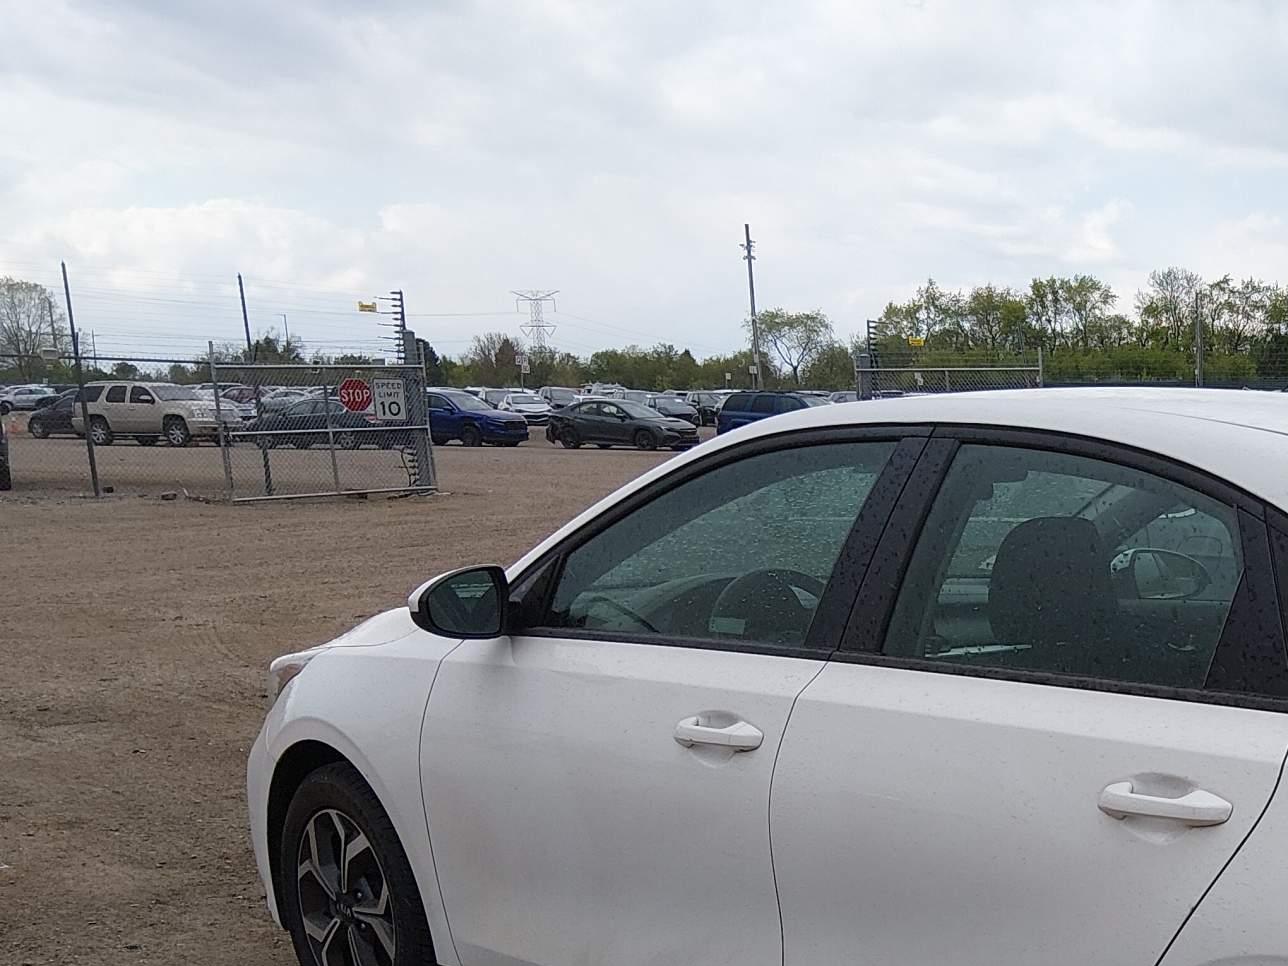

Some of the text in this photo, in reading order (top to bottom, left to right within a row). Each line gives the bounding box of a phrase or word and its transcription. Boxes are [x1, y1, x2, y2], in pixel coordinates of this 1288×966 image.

[375, 382, 402, 390] SPEED
[341, 389, 370, 402] STOP
[379, 391, 400, 399] LIMIT
[379, 400, 401, 417] 10
